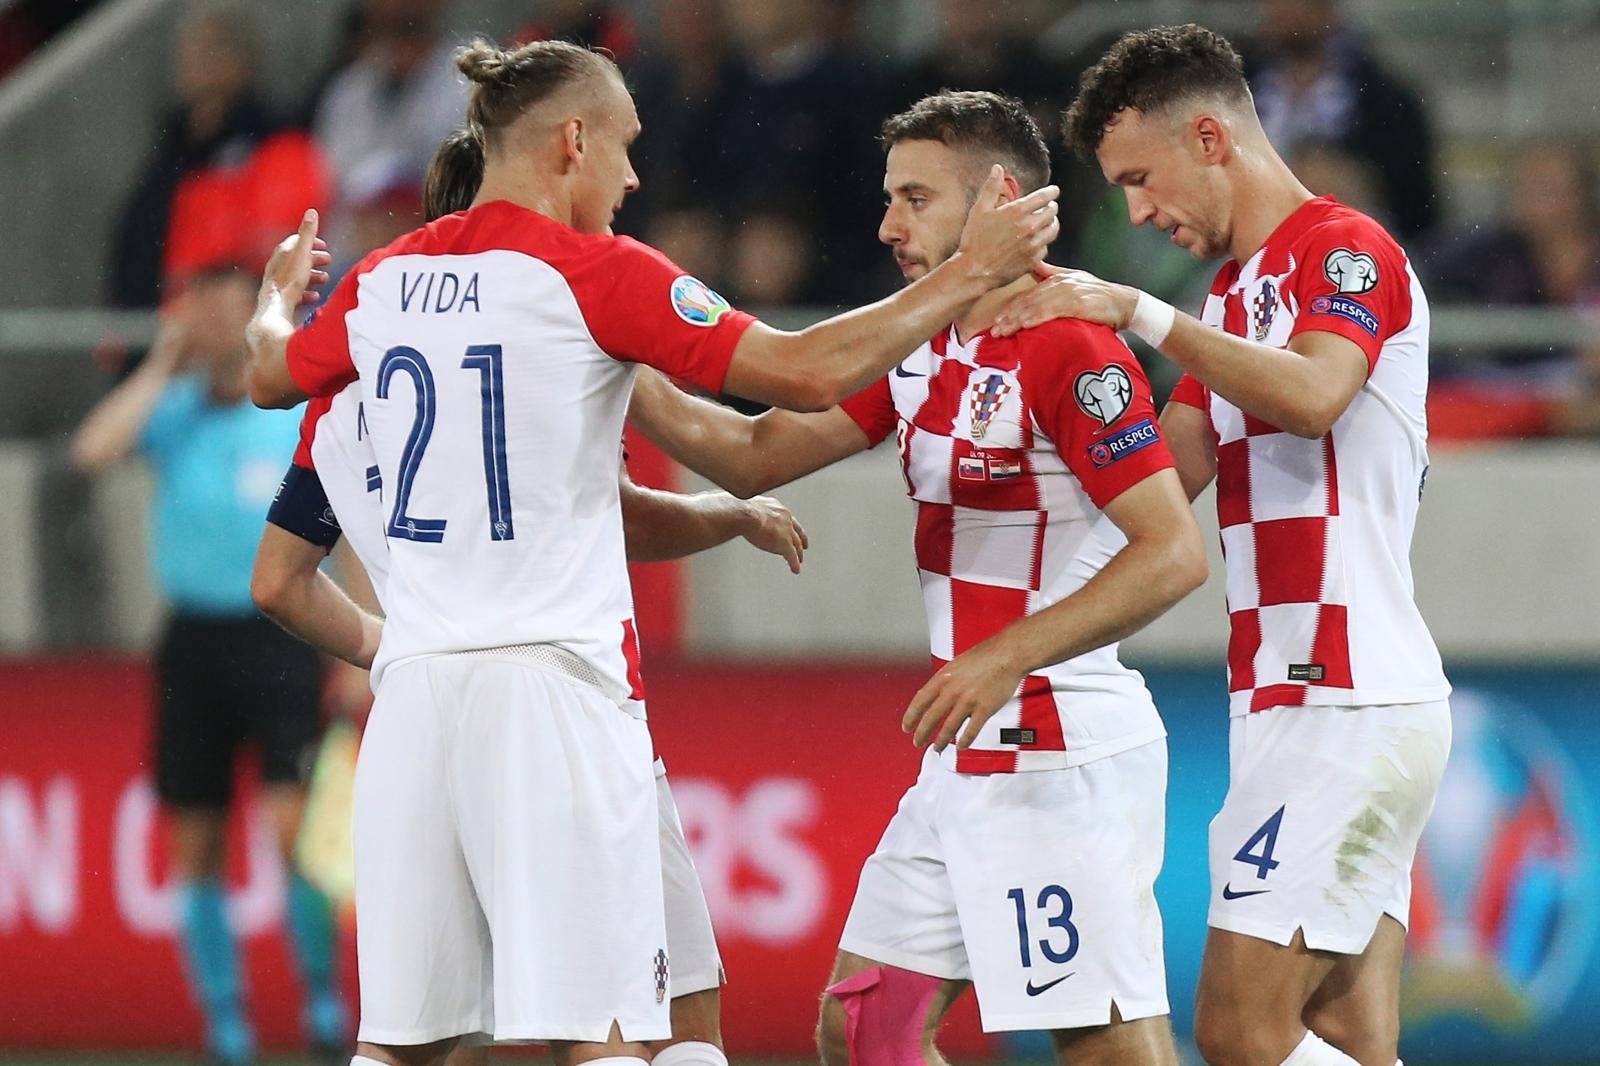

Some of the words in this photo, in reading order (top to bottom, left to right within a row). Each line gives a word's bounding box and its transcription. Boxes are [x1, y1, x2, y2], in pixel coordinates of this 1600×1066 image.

[400, 271, 481, 313] VIDA
[1332, 301, 1379, 332] RESPECT
[375, 344, 515, 543] 21
[1109, 424, 1156, 454] RESPECT
[1232, 803, 1285, 880] 4
[1006, 884, 1080, 968] 13
